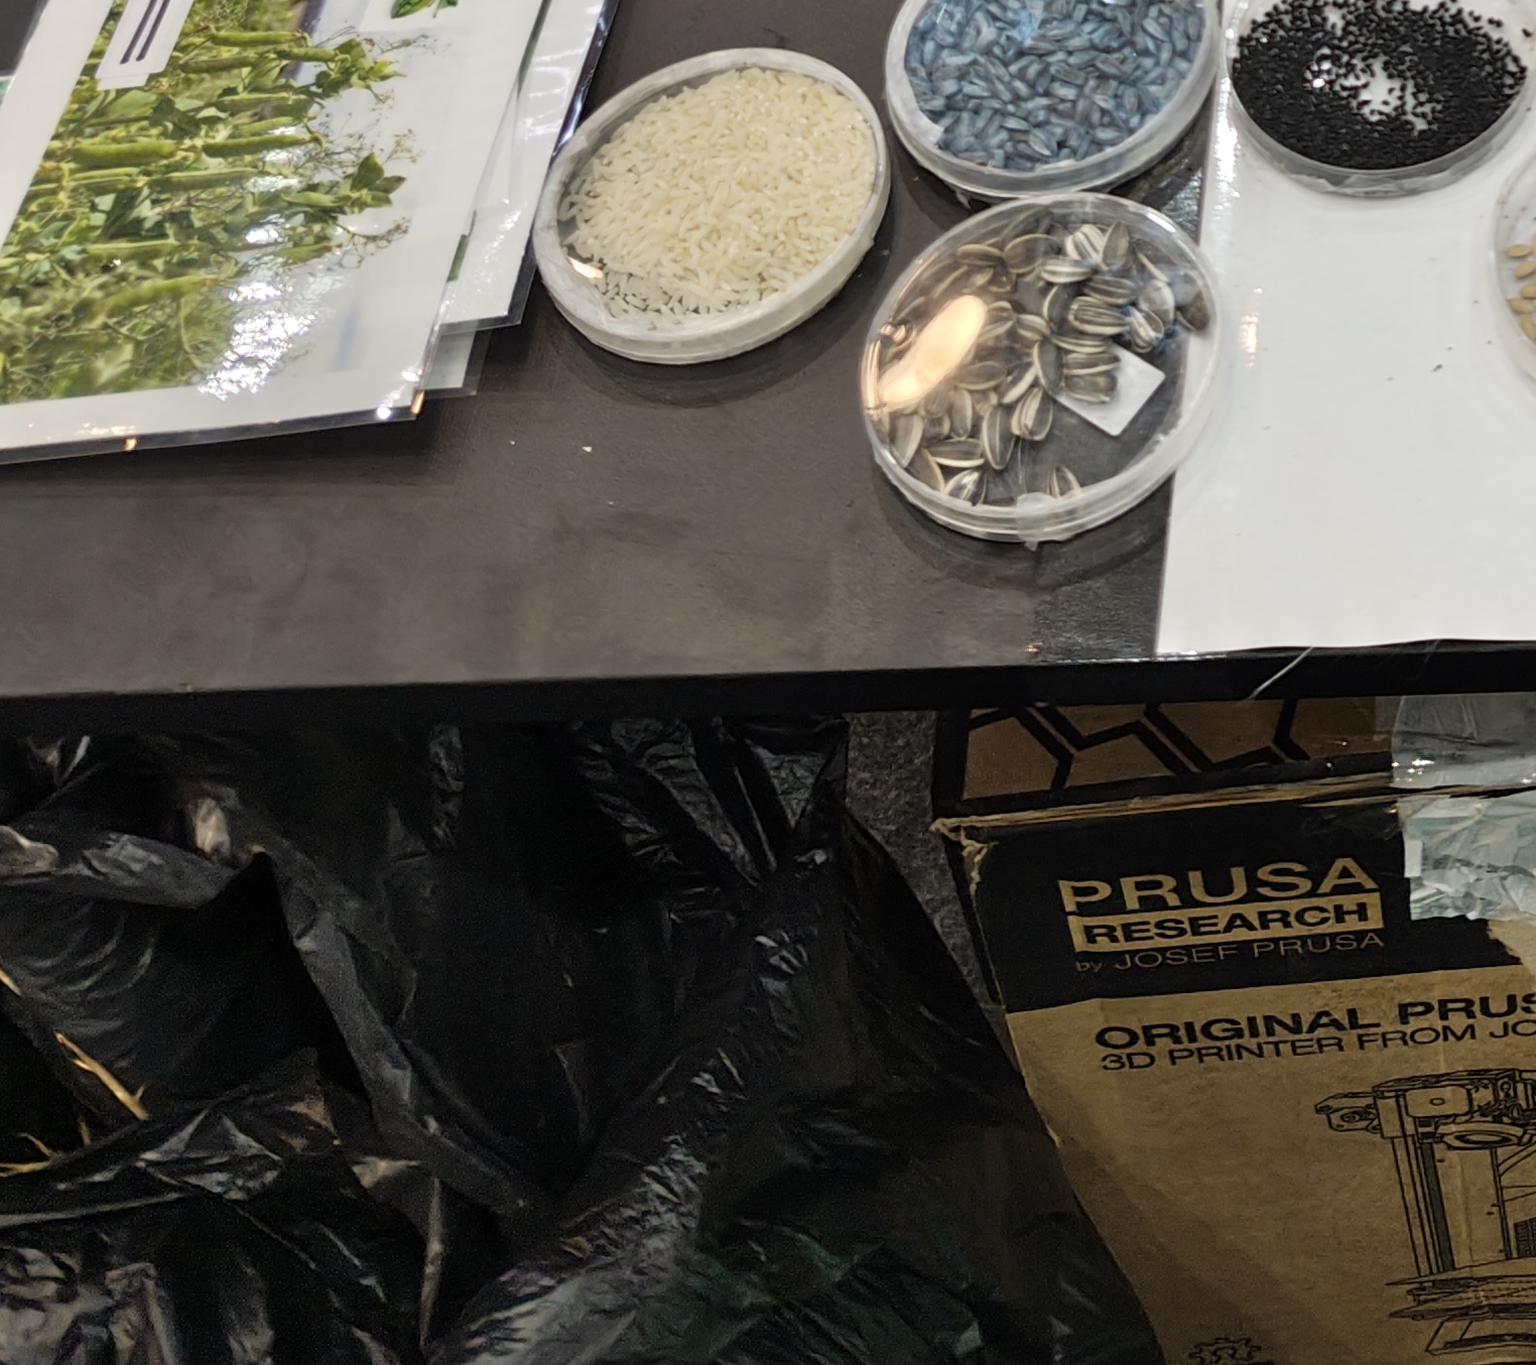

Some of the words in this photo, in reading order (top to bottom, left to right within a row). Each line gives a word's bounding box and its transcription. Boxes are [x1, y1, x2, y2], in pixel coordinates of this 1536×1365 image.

[1058, 857, 1379, 912] PRUSA
[1082, 901, 1369, 945] RESEARCH
[1075, 959, 1100, 973] by
[1115, 943, 1239, 970] JOSEF
[1252, 931, 1385, 958] PRUSA
[1095, 1007, 1381, 1050] ORIGINAL
[1101, 1051, 1156, 1071] 3D
[1169, 1035, 1345, 1066] PRINTER
[1357, 1021, 1477, 1051] FROM
